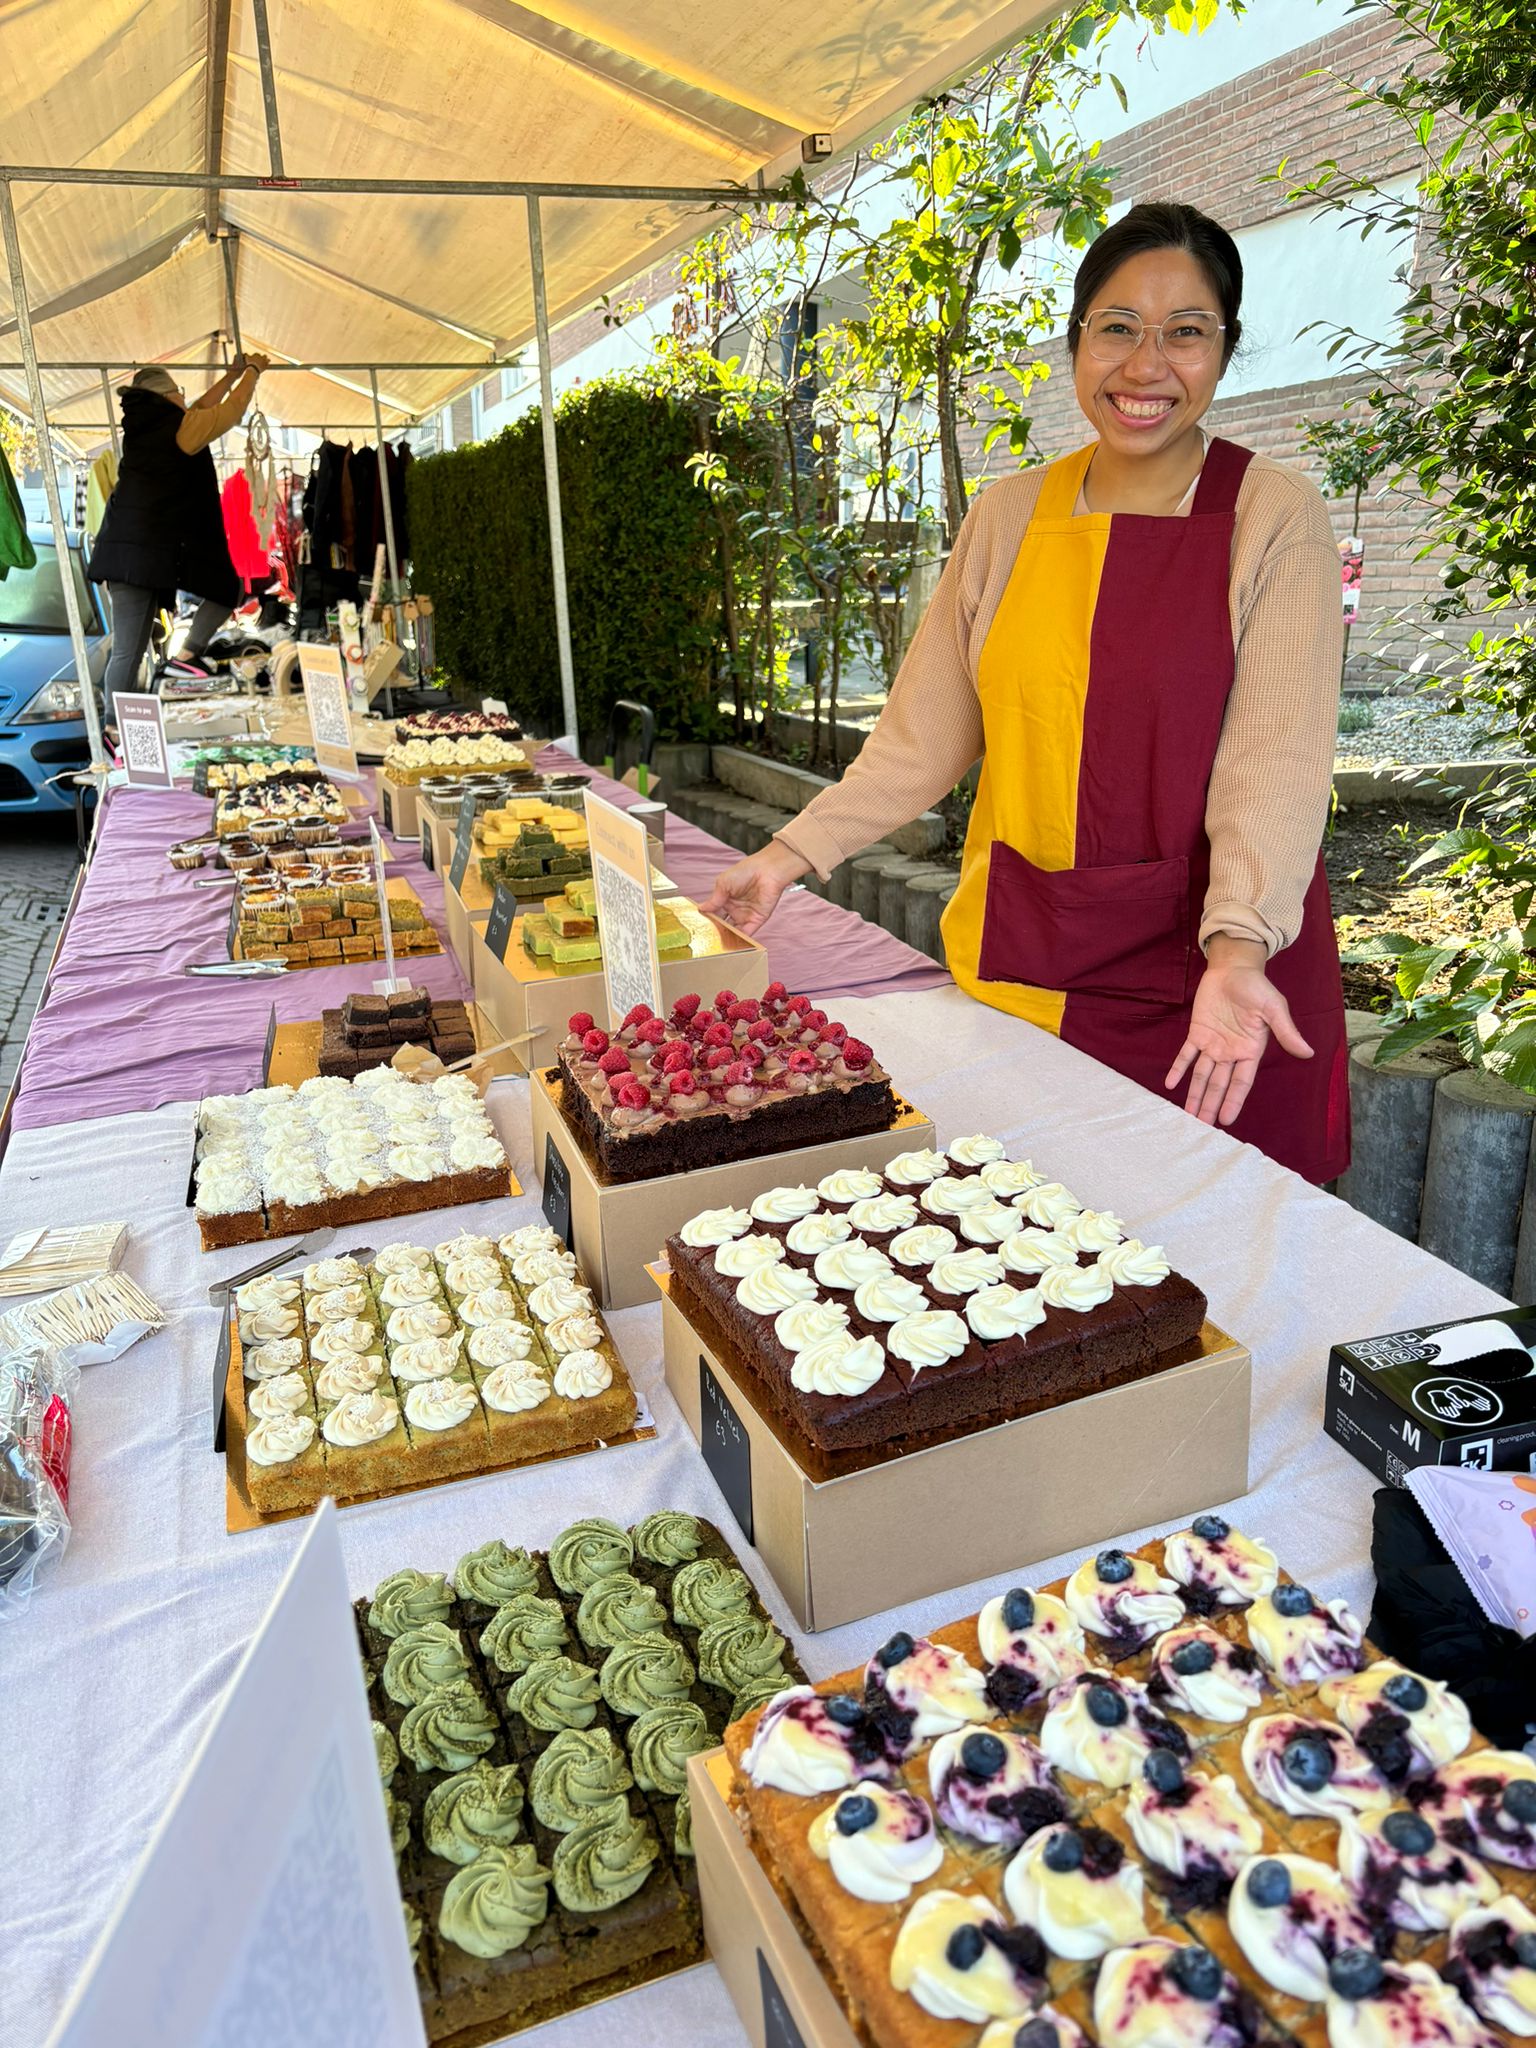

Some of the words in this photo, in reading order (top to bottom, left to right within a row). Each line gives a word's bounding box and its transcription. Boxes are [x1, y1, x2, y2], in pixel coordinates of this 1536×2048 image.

[124, 704, 136, 713] Scan
[1338, 1377, 1349, 1392] SK
[706, 1372, 716, 1403] Red
[718, 1395, 741, 1444] Velvet
[715, 1419, 726, 1447] €3
[1402, 1419, 1421, 1453] M
